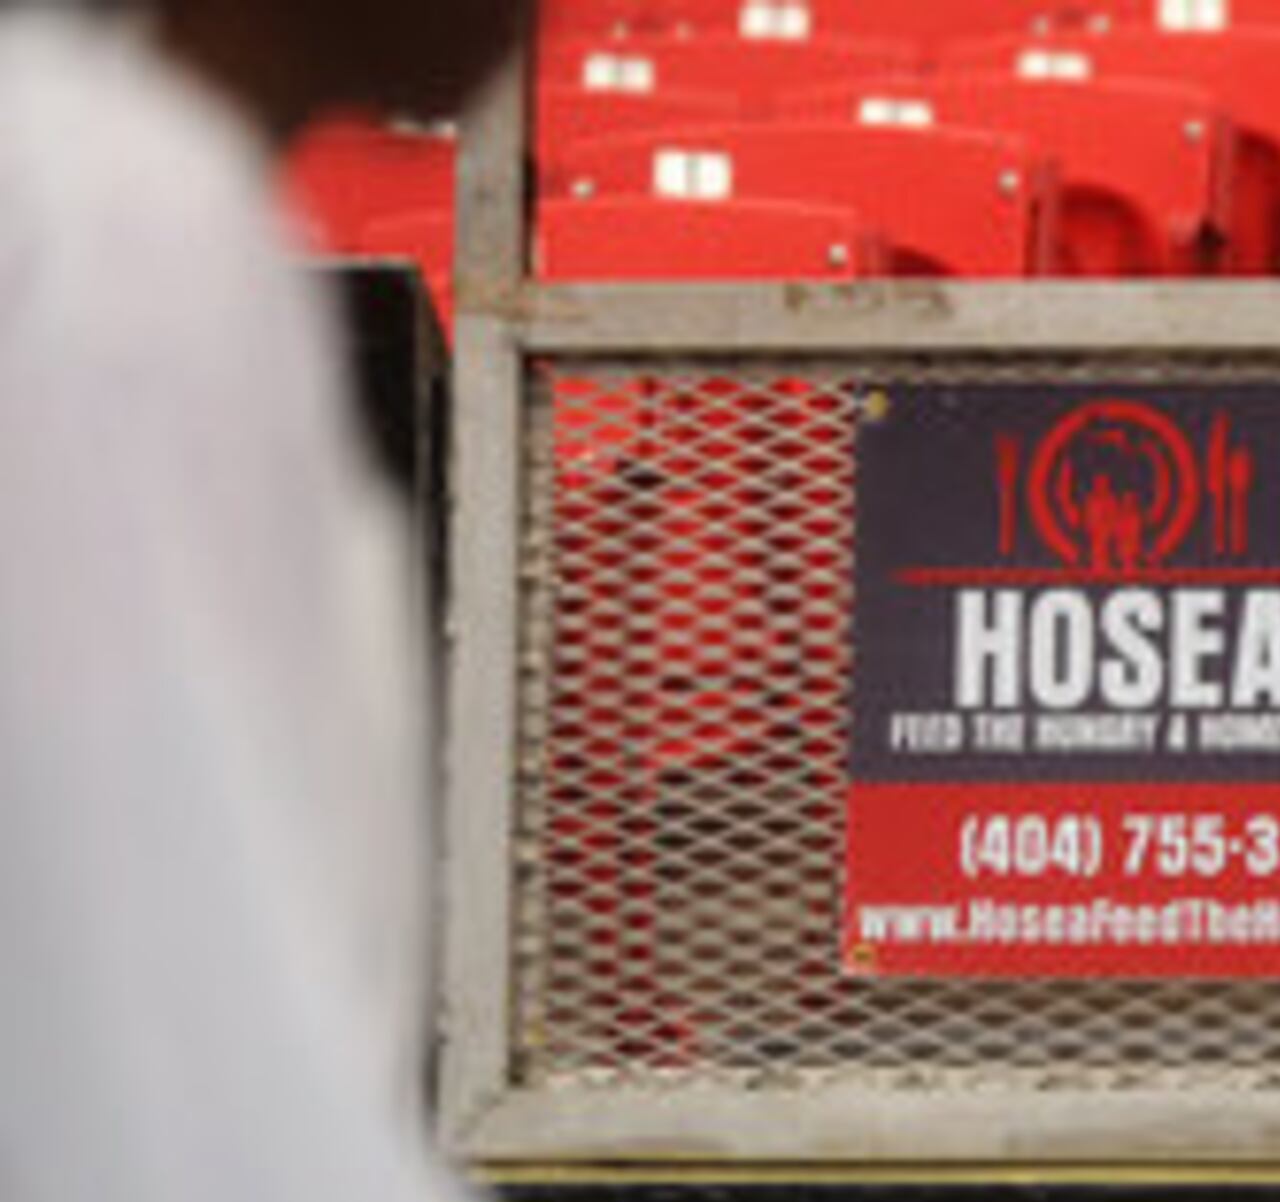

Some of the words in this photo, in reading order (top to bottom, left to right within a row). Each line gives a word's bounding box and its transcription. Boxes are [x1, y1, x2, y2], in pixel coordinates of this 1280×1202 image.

[890, 713, 963, 751] FEED
[972, 713, 1025, 751] THE
[1034, 713, 1159, 751] HUNGRY
[959, 813, 1102, 879] (404)
